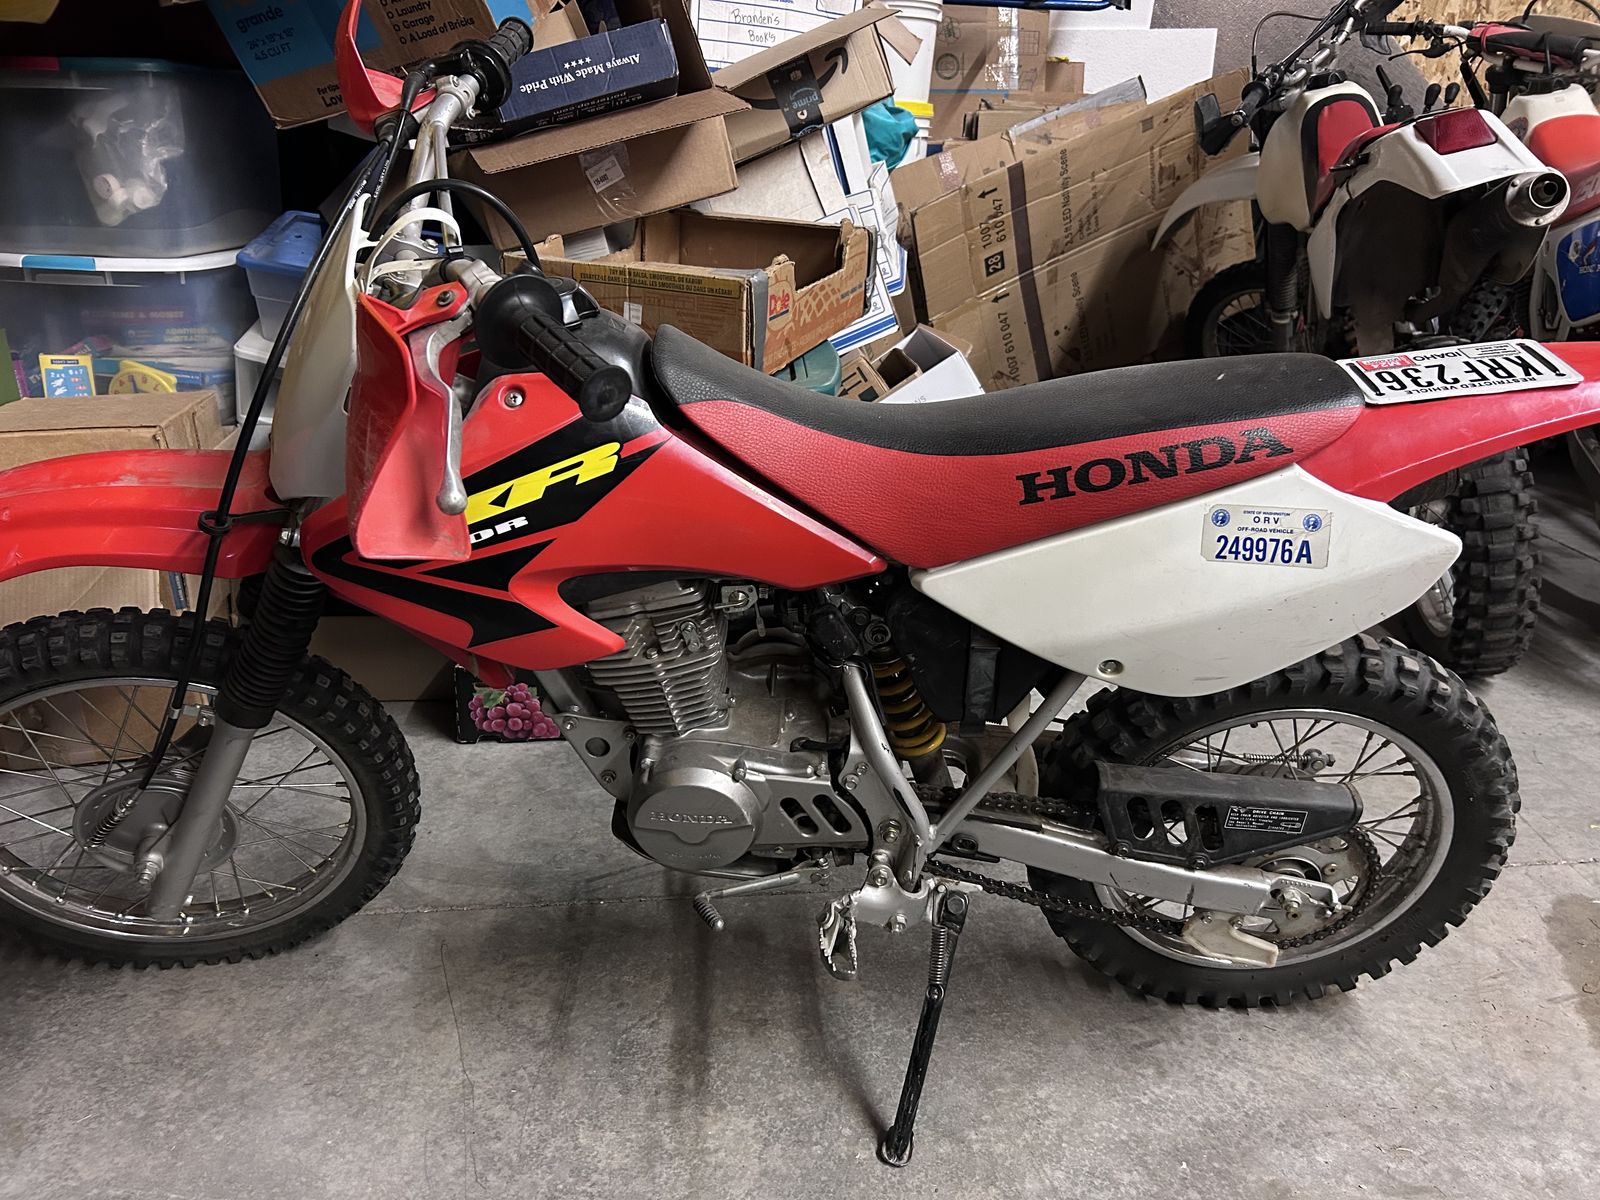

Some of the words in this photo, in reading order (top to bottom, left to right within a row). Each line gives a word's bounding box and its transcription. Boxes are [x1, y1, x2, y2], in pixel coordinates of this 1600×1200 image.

[395, 0, 431, 17] Laundry
[731, 8, 780, 25] Branden's
[236, 5, 284, 33] grande
[402, 15, 435, 29] Garage
[409, 33, 416, 42] A
[415, 26, 438, 40] Load
[439, 23, 448, 33] of
[448, 17, 475, 31] Bricks
[606, 53, 640, 69] Always
[549, 72, 575, 86] With
[575, 65, 605, 78] Made
[520, 79, 549, 94] Pride
[792, 91, 819, 109] prime
[1059, 148, 1069, 177] Scene
[979, 222, 993, 250] 1007
[994, 220, 1007, 243] 610
[988, 255, 1002, 273] 28
[769, 289, 790, 316] Dole
[997, 312, 1011, 332] 047
[1002, 332, 1015, 354] 610
[1413, 351, 1462, 362] IDAHO
[1375, 363, 1459, 391] 236
[1463, 355, 1544, 382] KRF
[1406, 384, 1457, 395] VEHICLE
[1457, 376, 1537, 390] RESTRICTED
[1015, 427, 1293, 506] HONDA
[1215, 535, 1313, 564] 249976A
[649, 810, 733, 824] HONDA
